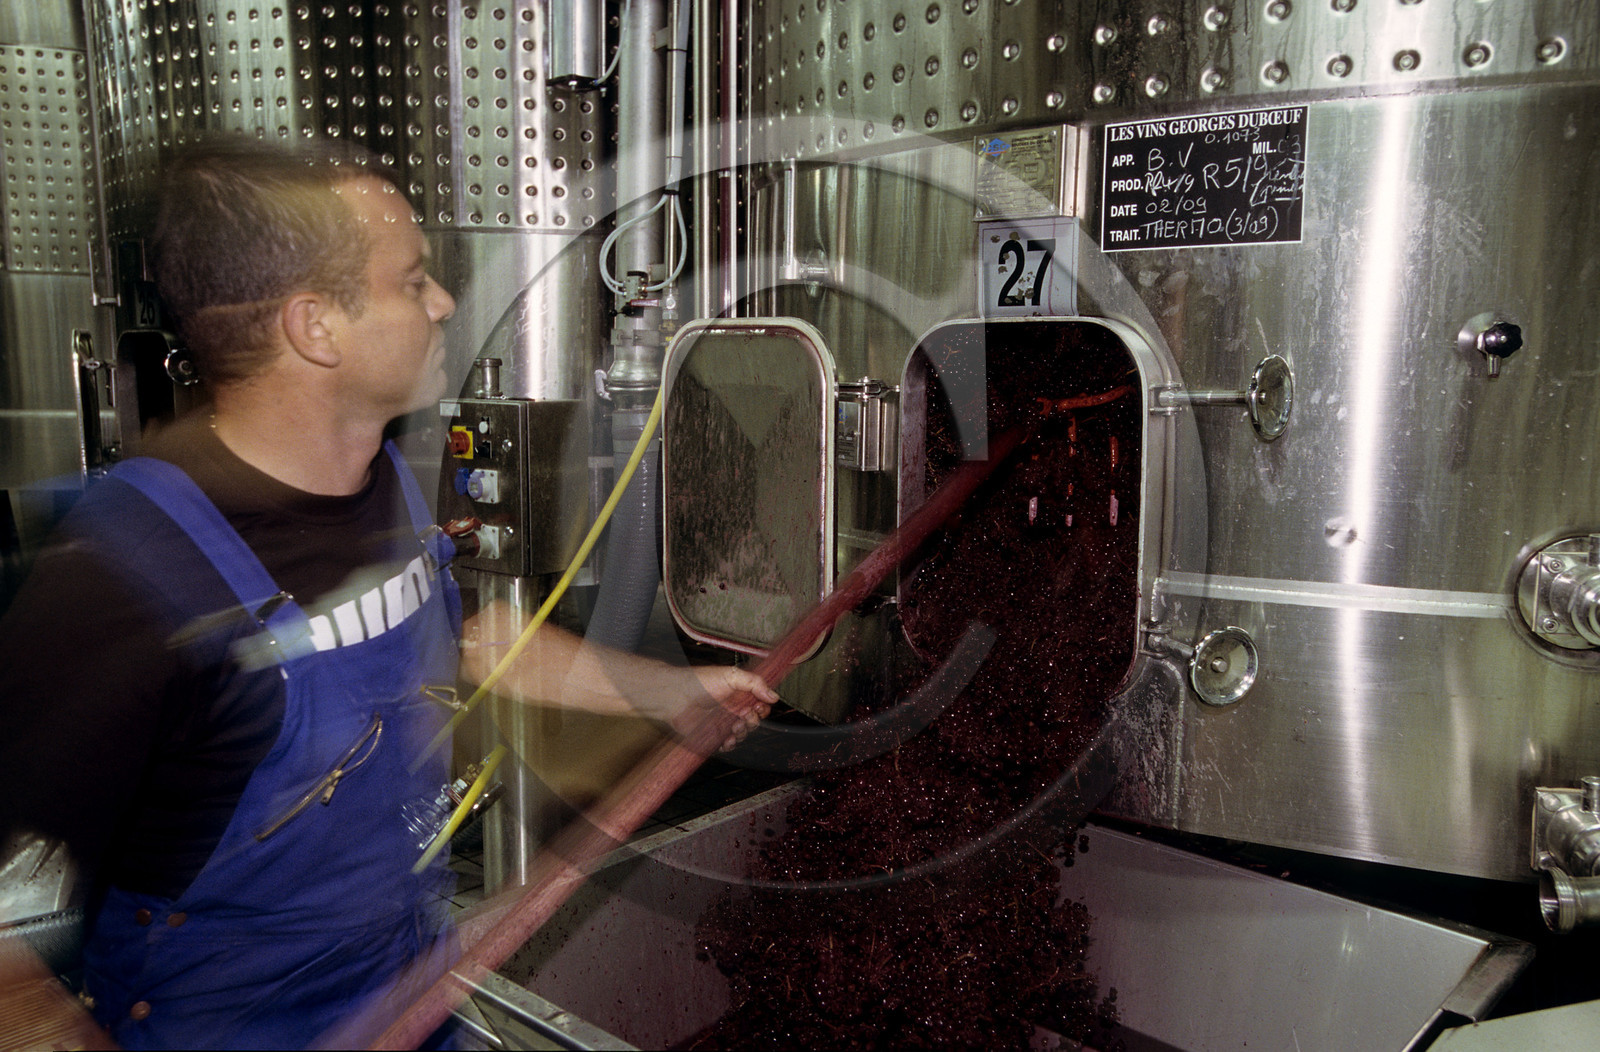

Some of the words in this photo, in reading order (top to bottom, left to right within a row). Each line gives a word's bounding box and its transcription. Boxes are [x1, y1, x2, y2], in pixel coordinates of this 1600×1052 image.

[1110, 126, 1135, 142] LES
[1136, 122, 1167, 139] VINS
[1168, 114, 1236, 135] GEORGES
[1252, 141, 1277, 155] MIL.
[1111, 154, 1136, 168] APP.
[1111, 177, 1144, 192] PROD.
[1110, 203, 1138, 218] DATE
[1145, 196, 1207, 215] 02/09
[1110, 229, 1141, 242] TRAIT.
[997, 238, 1056, 307] 27
[139, 290, 155, 325] 26
